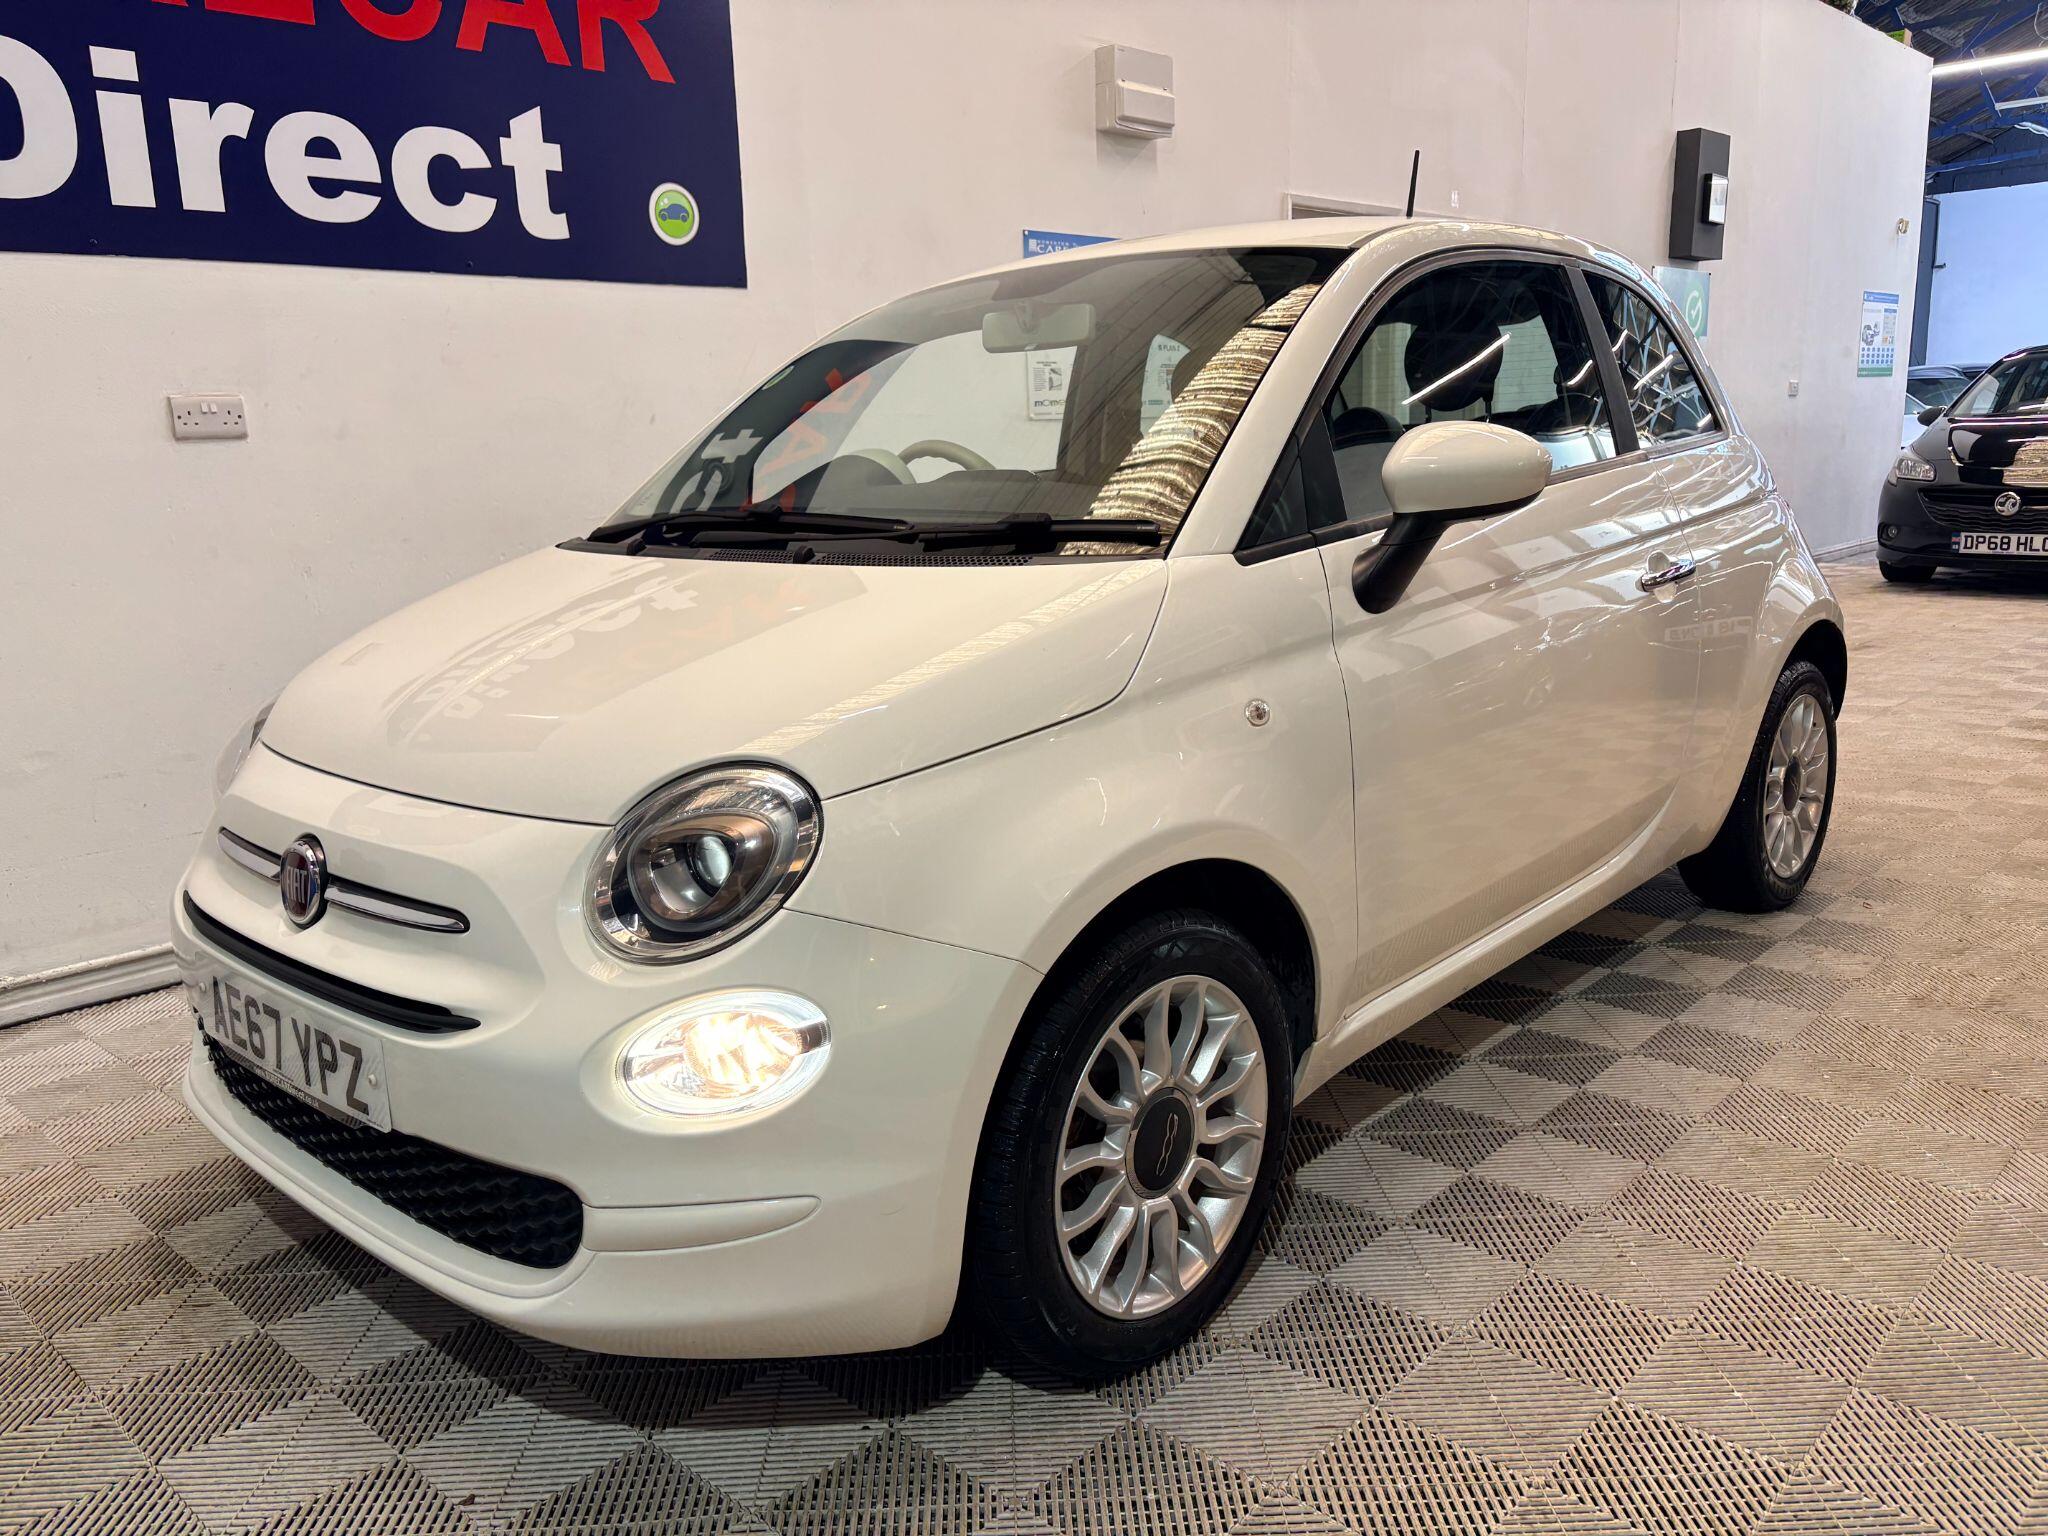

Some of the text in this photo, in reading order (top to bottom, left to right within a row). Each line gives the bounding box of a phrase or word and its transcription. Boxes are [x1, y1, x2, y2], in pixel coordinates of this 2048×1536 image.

[1963, 535, 2011, 551] DP68
[212, 976, 282, 1071] AE67
[290, 1017, 370, 1116] YPZ
